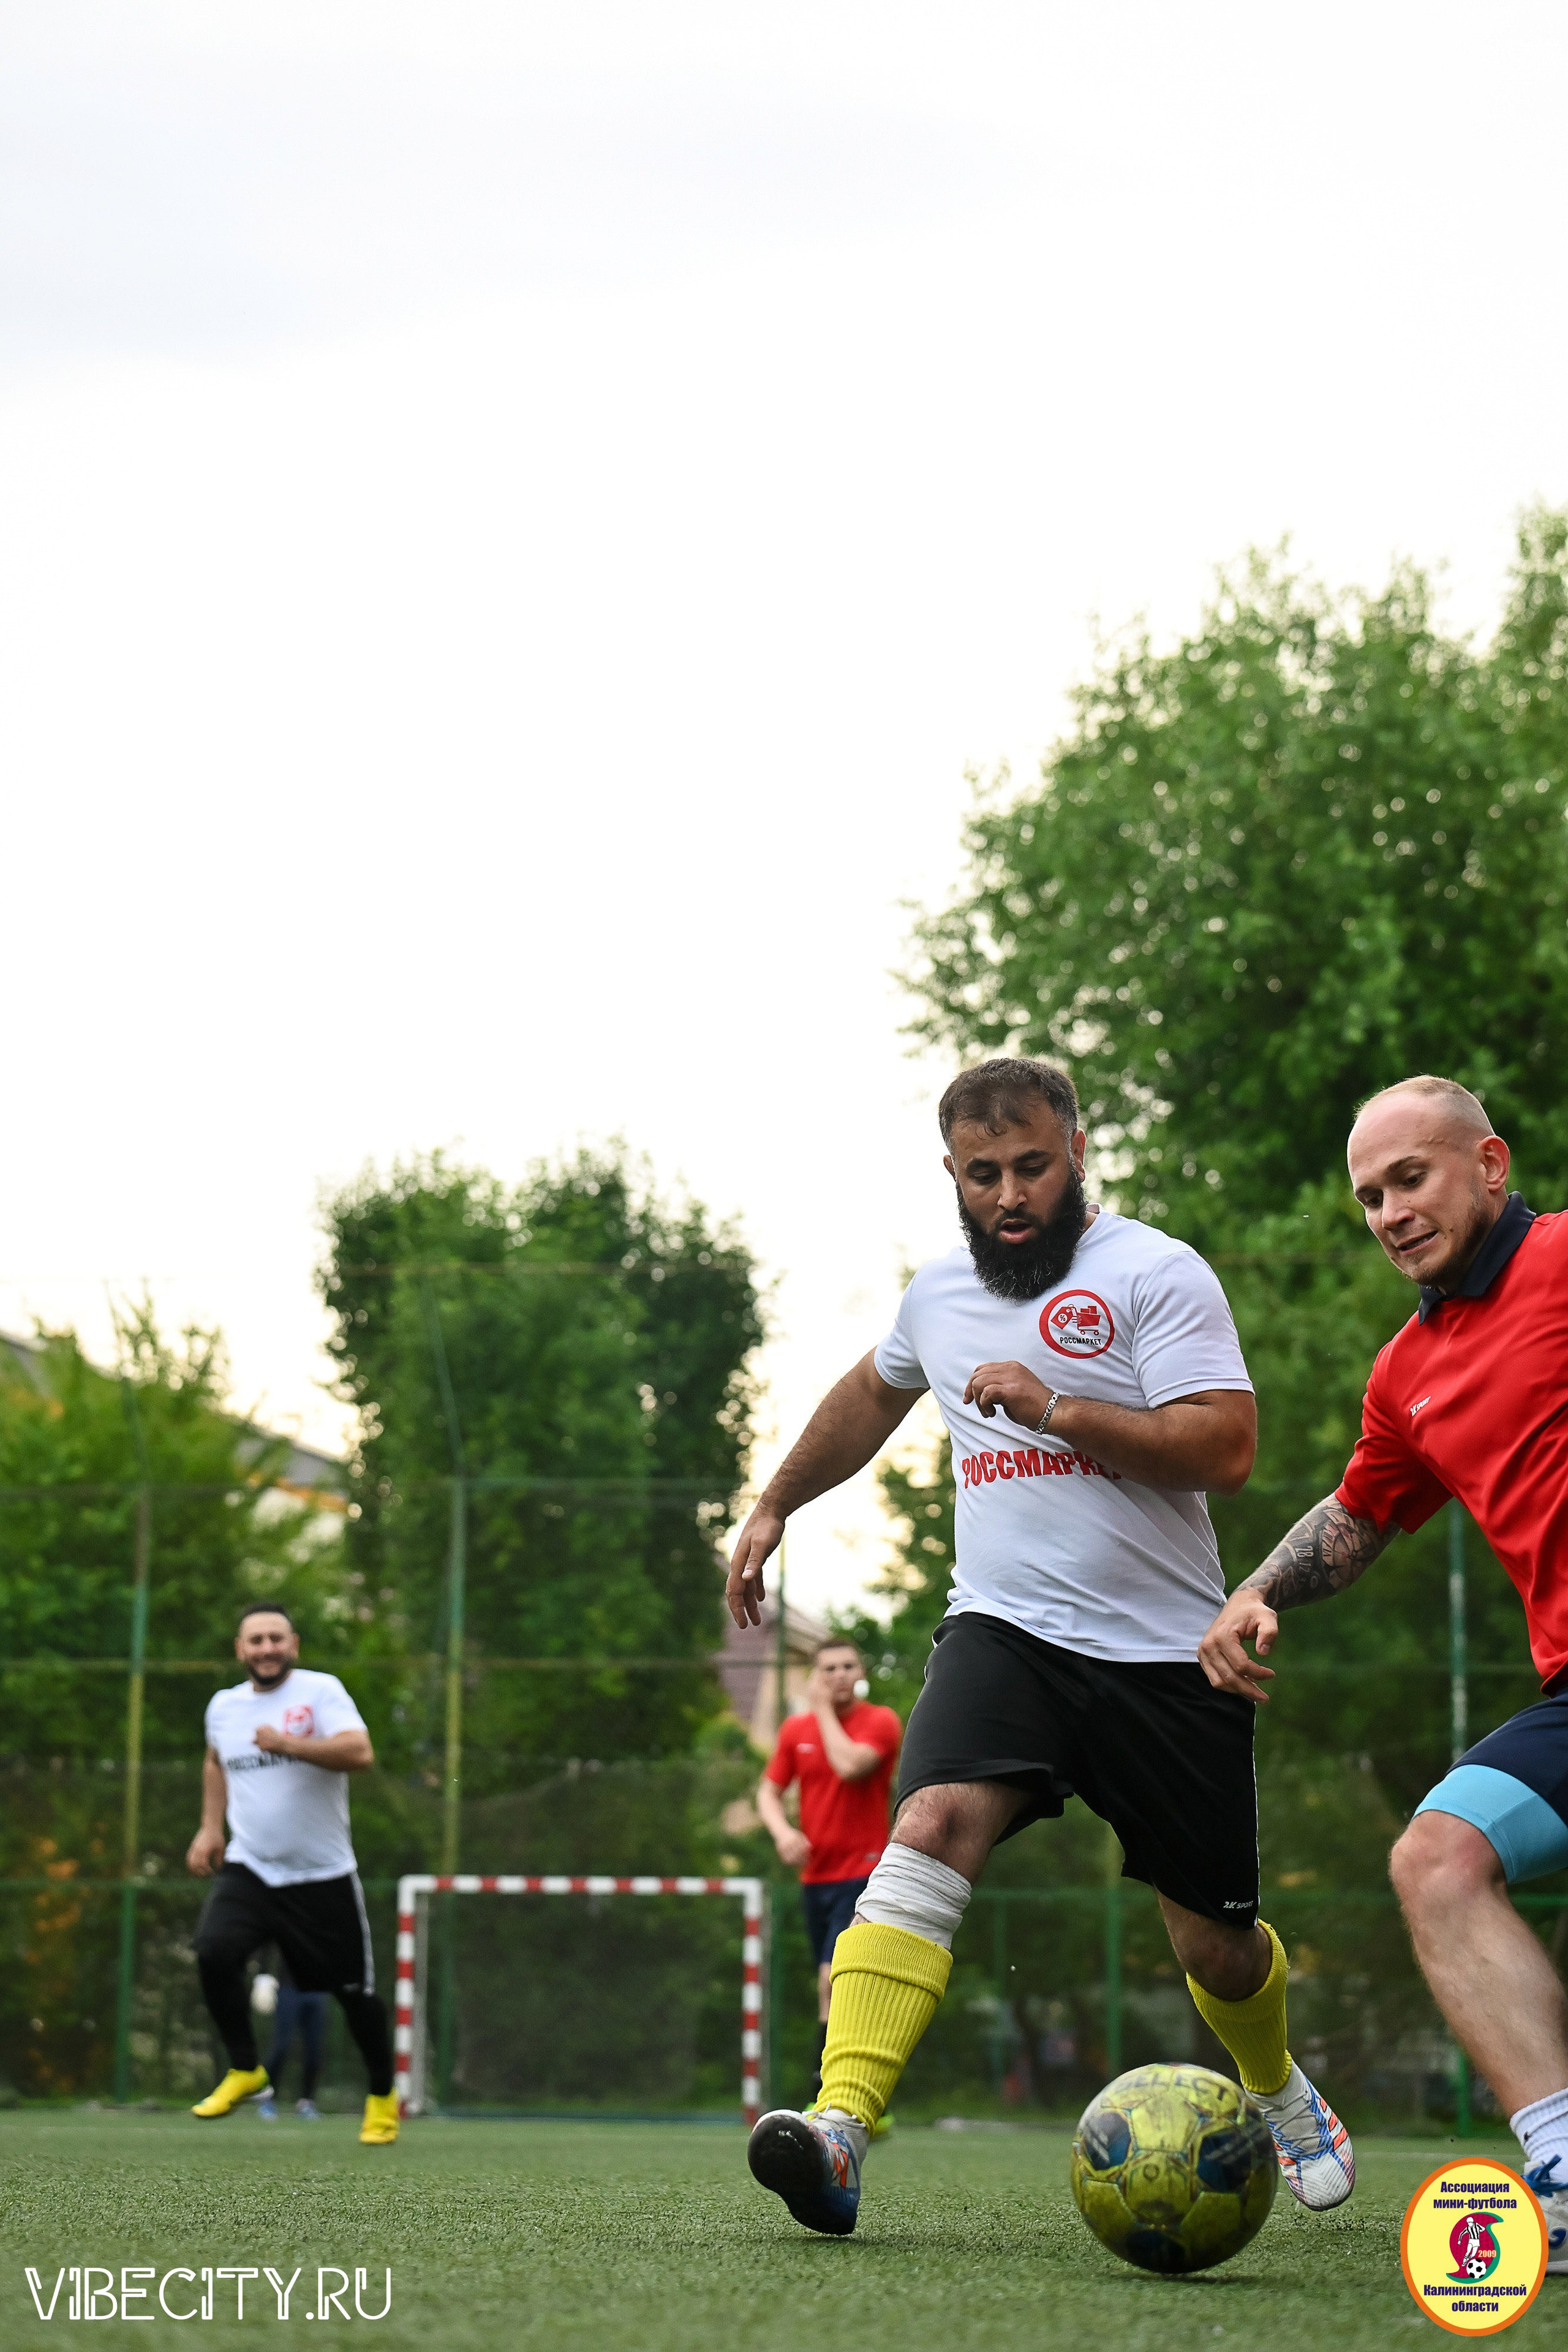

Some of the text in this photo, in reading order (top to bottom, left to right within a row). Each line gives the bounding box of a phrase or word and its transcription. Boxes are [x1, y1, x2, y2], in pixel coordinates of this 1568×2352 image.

[1060, 1336, 1101, 1346] РОССМАРКЕТ
[962, 1448, 1122, 1489] РОССМАРК
[1236, 1900, 1254, 1909] SPORT
